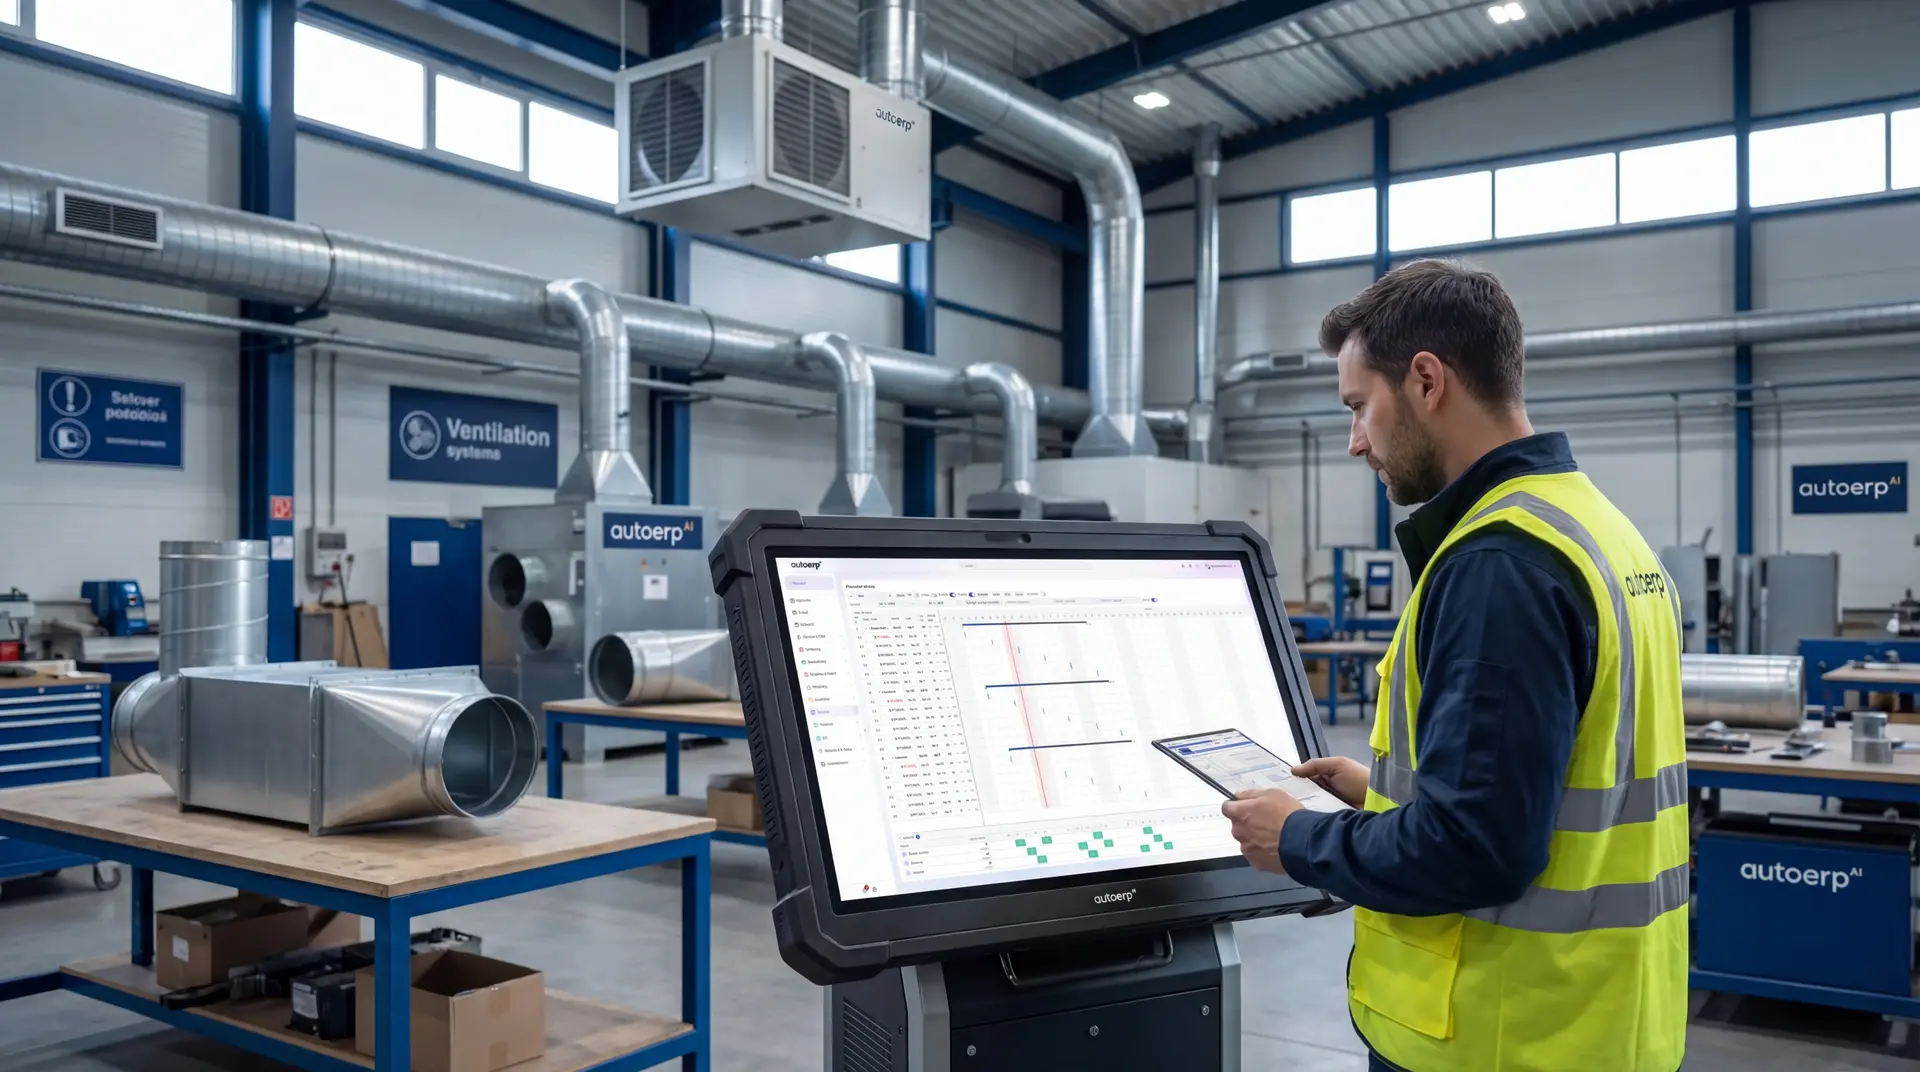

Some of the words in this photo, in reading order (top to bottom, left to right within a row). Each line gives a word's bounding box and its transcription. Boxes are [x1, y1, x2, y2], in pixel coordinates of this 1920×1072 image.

[446, 417, 550, 448] Ventilation
[446, 446, 501, 462] systems
[790, 560, 822, 570] autoerp
[1625, 569, 1665, 599] autoerp
